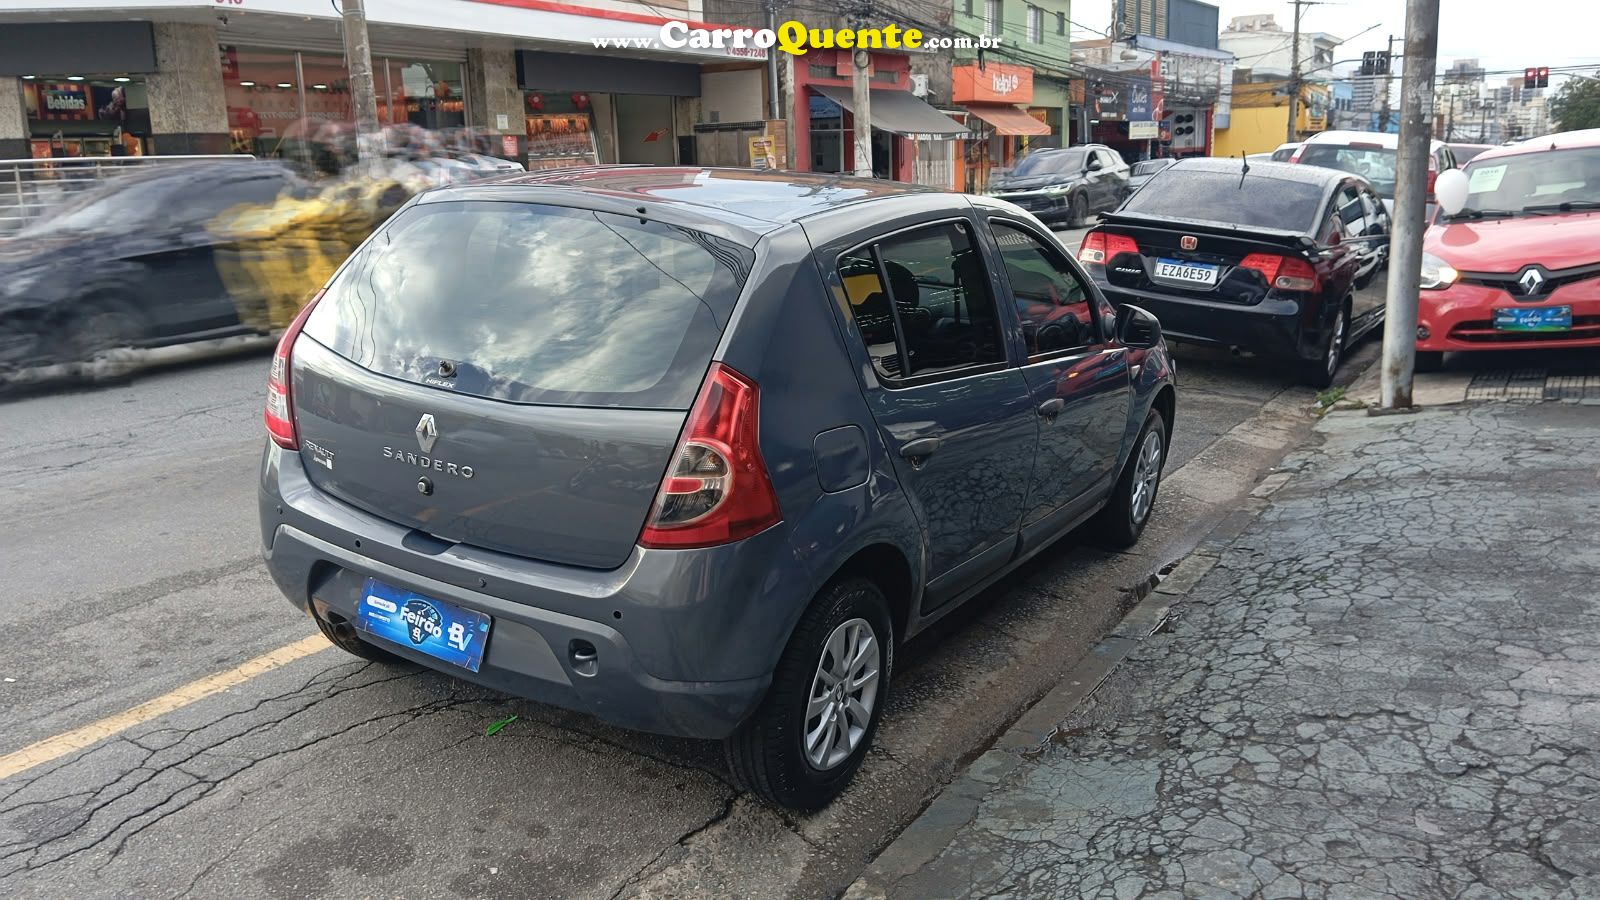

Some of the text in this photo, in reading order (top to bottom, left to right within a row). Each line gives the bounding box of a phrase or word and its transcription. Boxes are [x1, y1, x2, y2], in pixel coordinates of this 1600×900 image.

[46, 95, 86, 110] Bebidas
[1161, 264, 1212, 282] EZA6E59
[383, 446, 475, 479] SANDERO
[400, 606, 442, 638] Feirão
